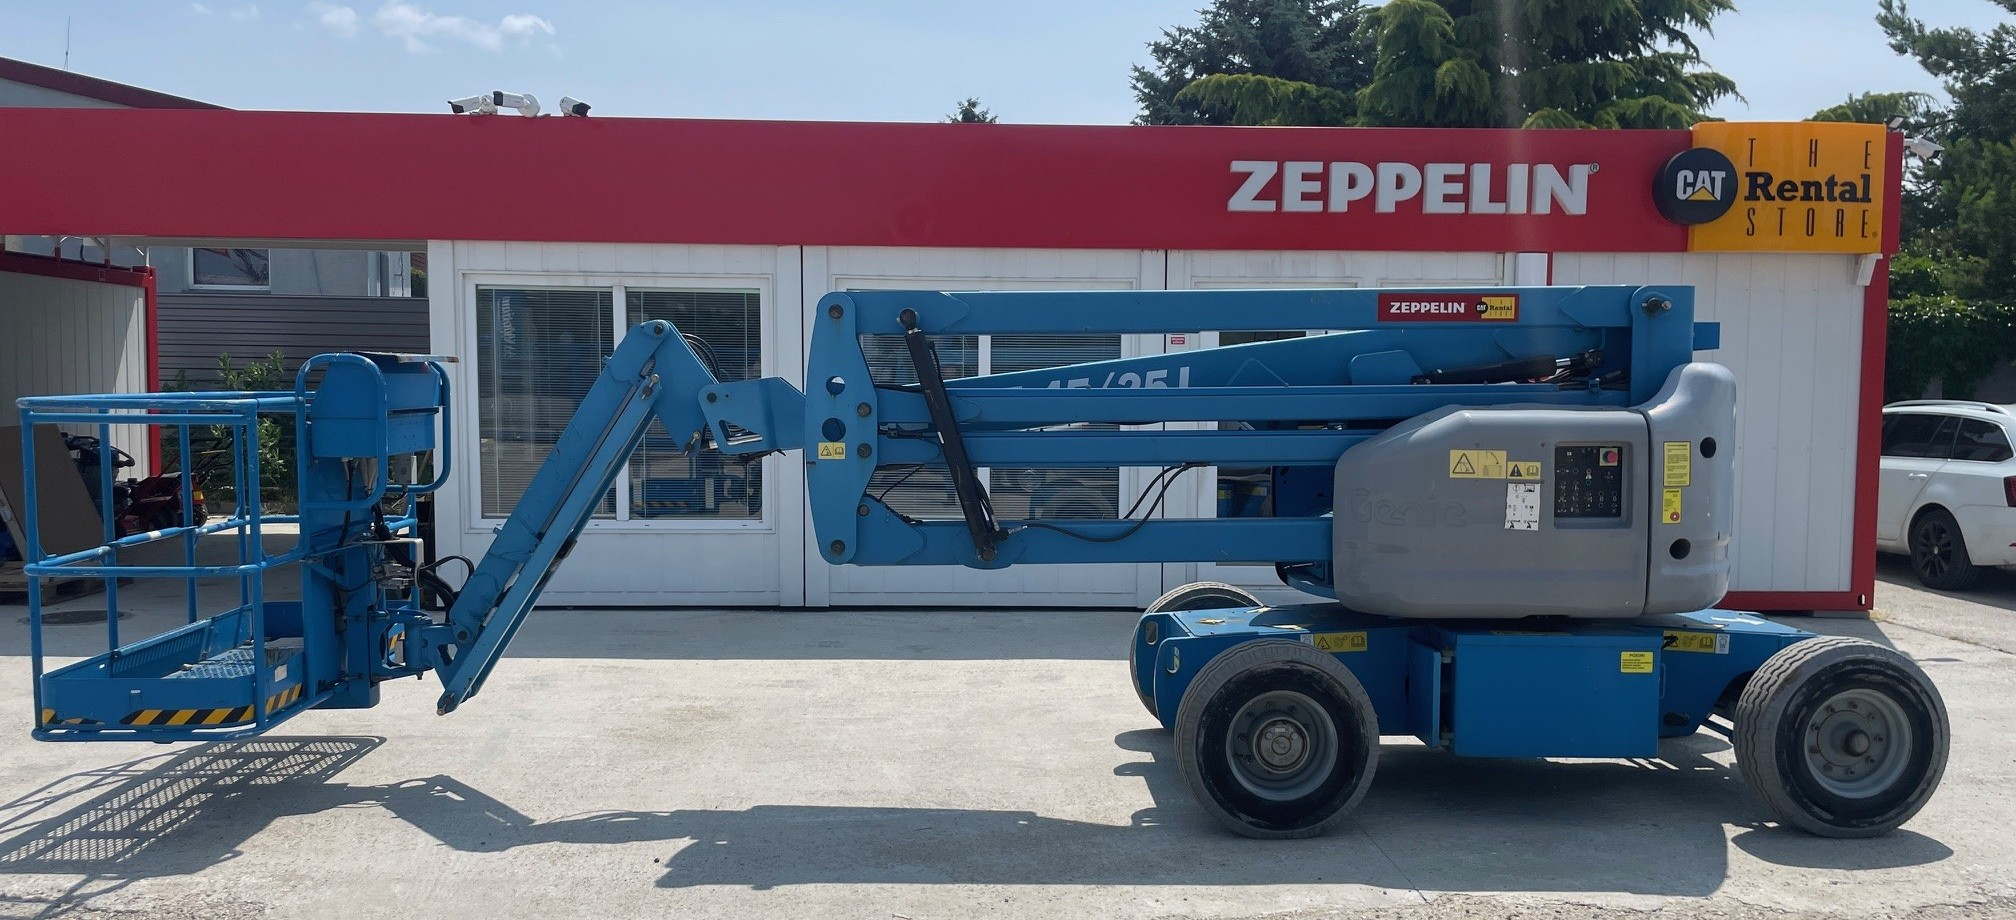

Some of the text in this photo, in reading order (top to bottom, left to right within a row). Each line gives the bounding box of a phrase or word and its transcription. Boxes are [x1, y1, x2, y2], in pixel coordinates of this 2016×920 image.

[1747, 137, 1872, 170] THE
[1675, 169, 1726, 201] CAT
[1744, 171, 1872, 203] Rental
[1746, 207, 1870, 238] STORE
[1389, 301, 1466, 314] ZEPPELIN
